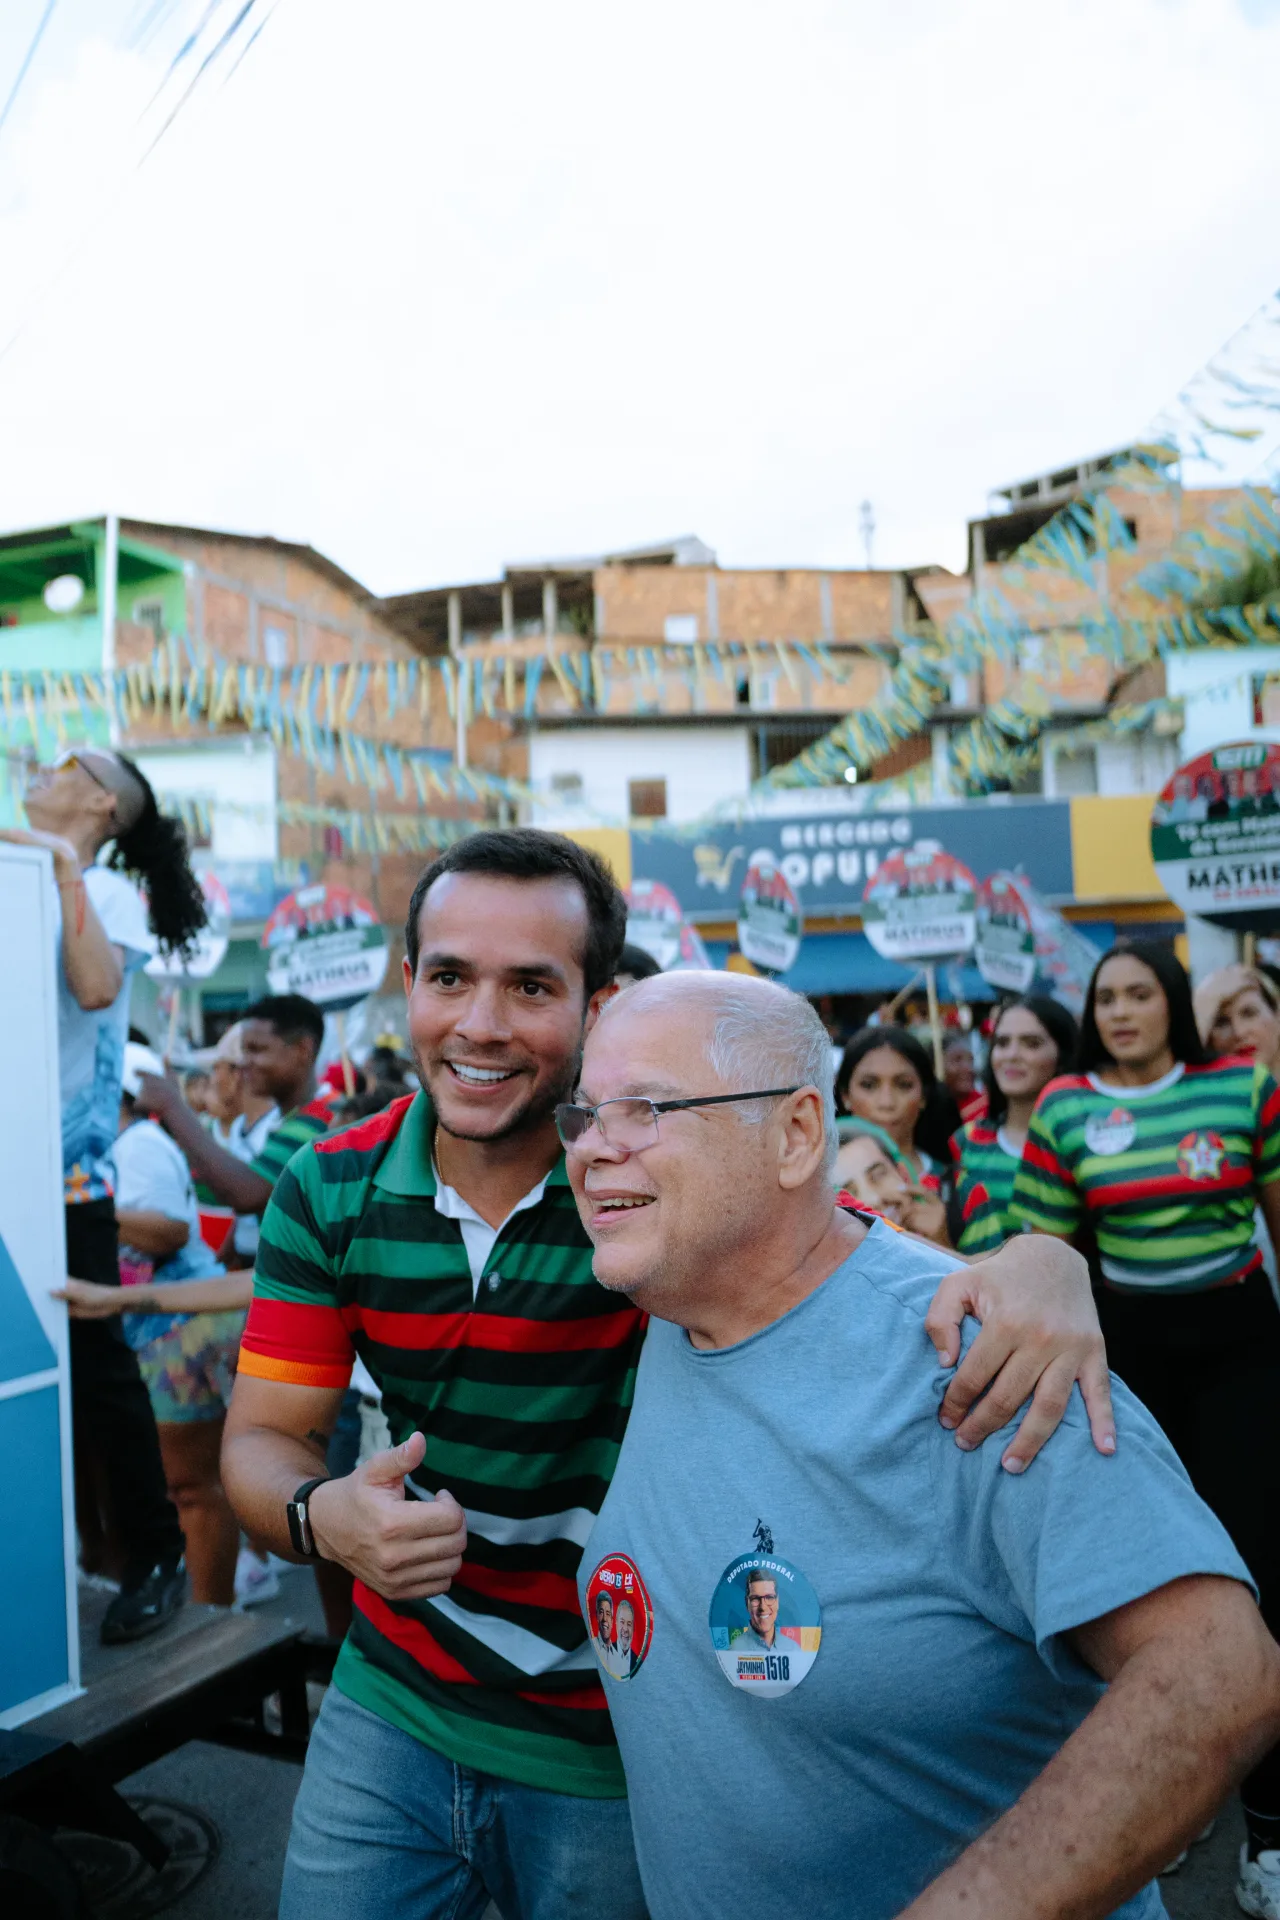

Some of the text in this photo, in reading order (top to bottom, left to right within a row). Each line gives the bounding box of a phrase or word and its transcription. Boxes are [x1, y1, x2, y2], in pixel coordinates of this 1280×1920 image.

[781, 818, 911, 849] MERCADO
[727, 1560, 795, 1584] DEPUTADO FEDERAL
[736, 1661, 765, 1674] JAYMINHO
[764, 1655, 790, 1681] 1518
